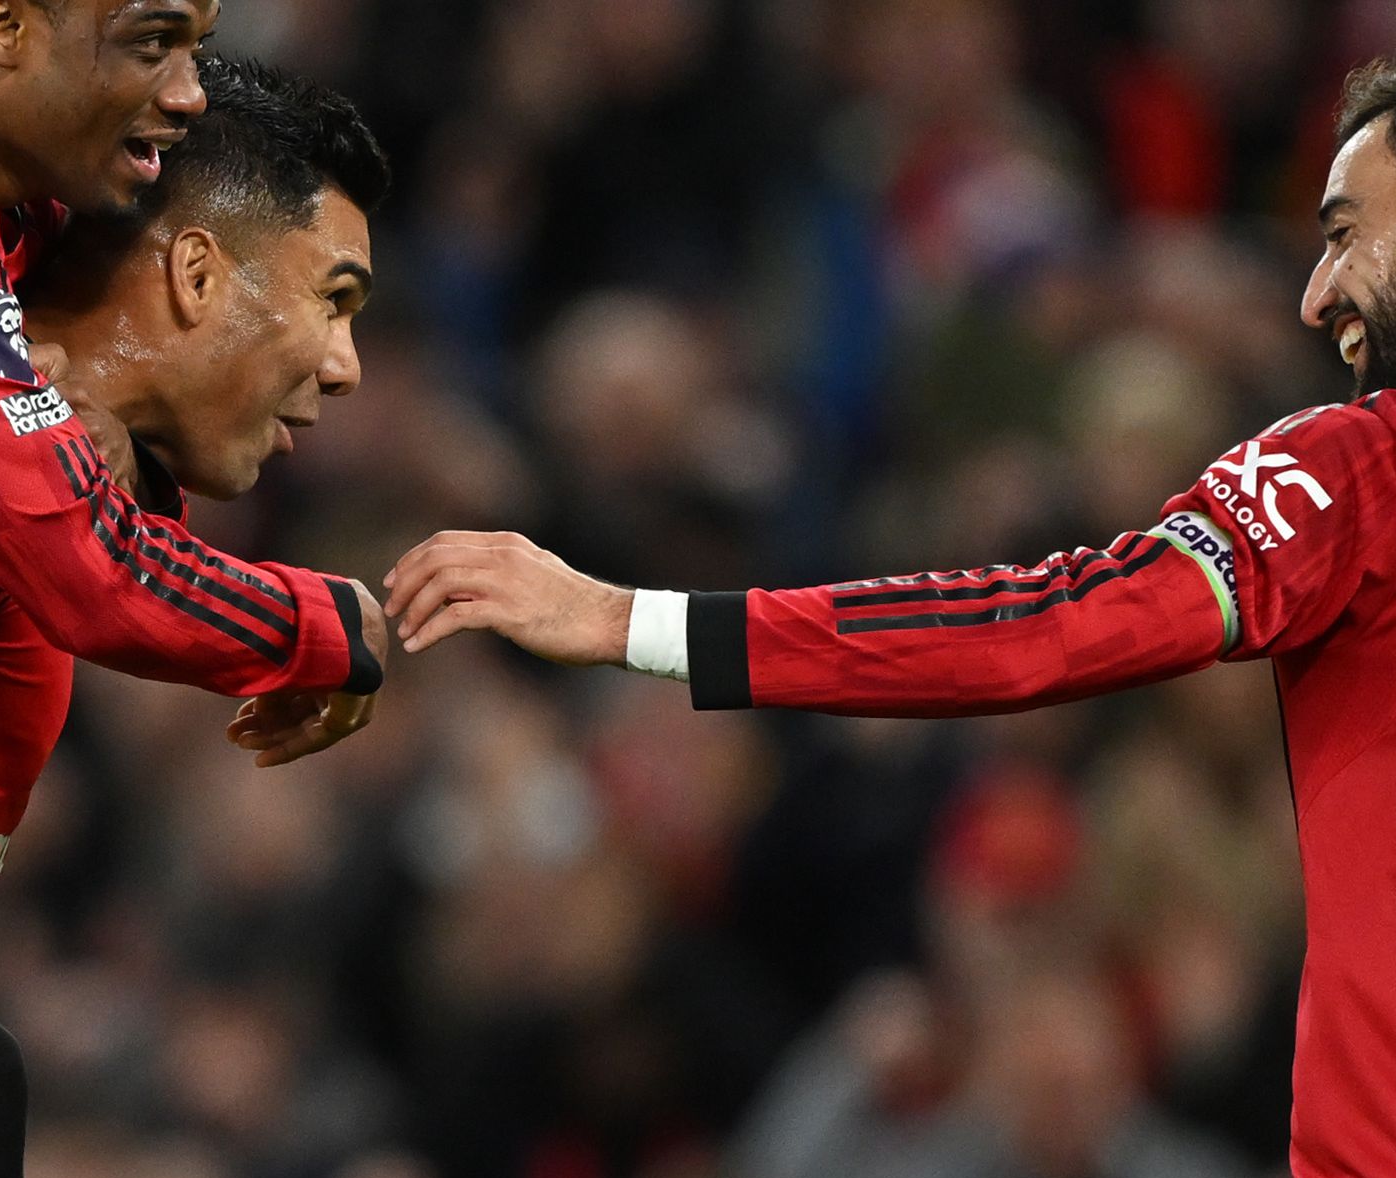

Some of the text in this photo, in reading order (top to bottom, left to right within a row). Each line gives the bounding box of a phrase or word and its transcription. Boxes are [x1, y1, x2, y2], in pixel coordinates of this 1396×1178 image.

[0, 396, 32, 416] No
[1200, 471, 1278, 551] NOLOGY
[1164, 514, 1239, 612] capta
